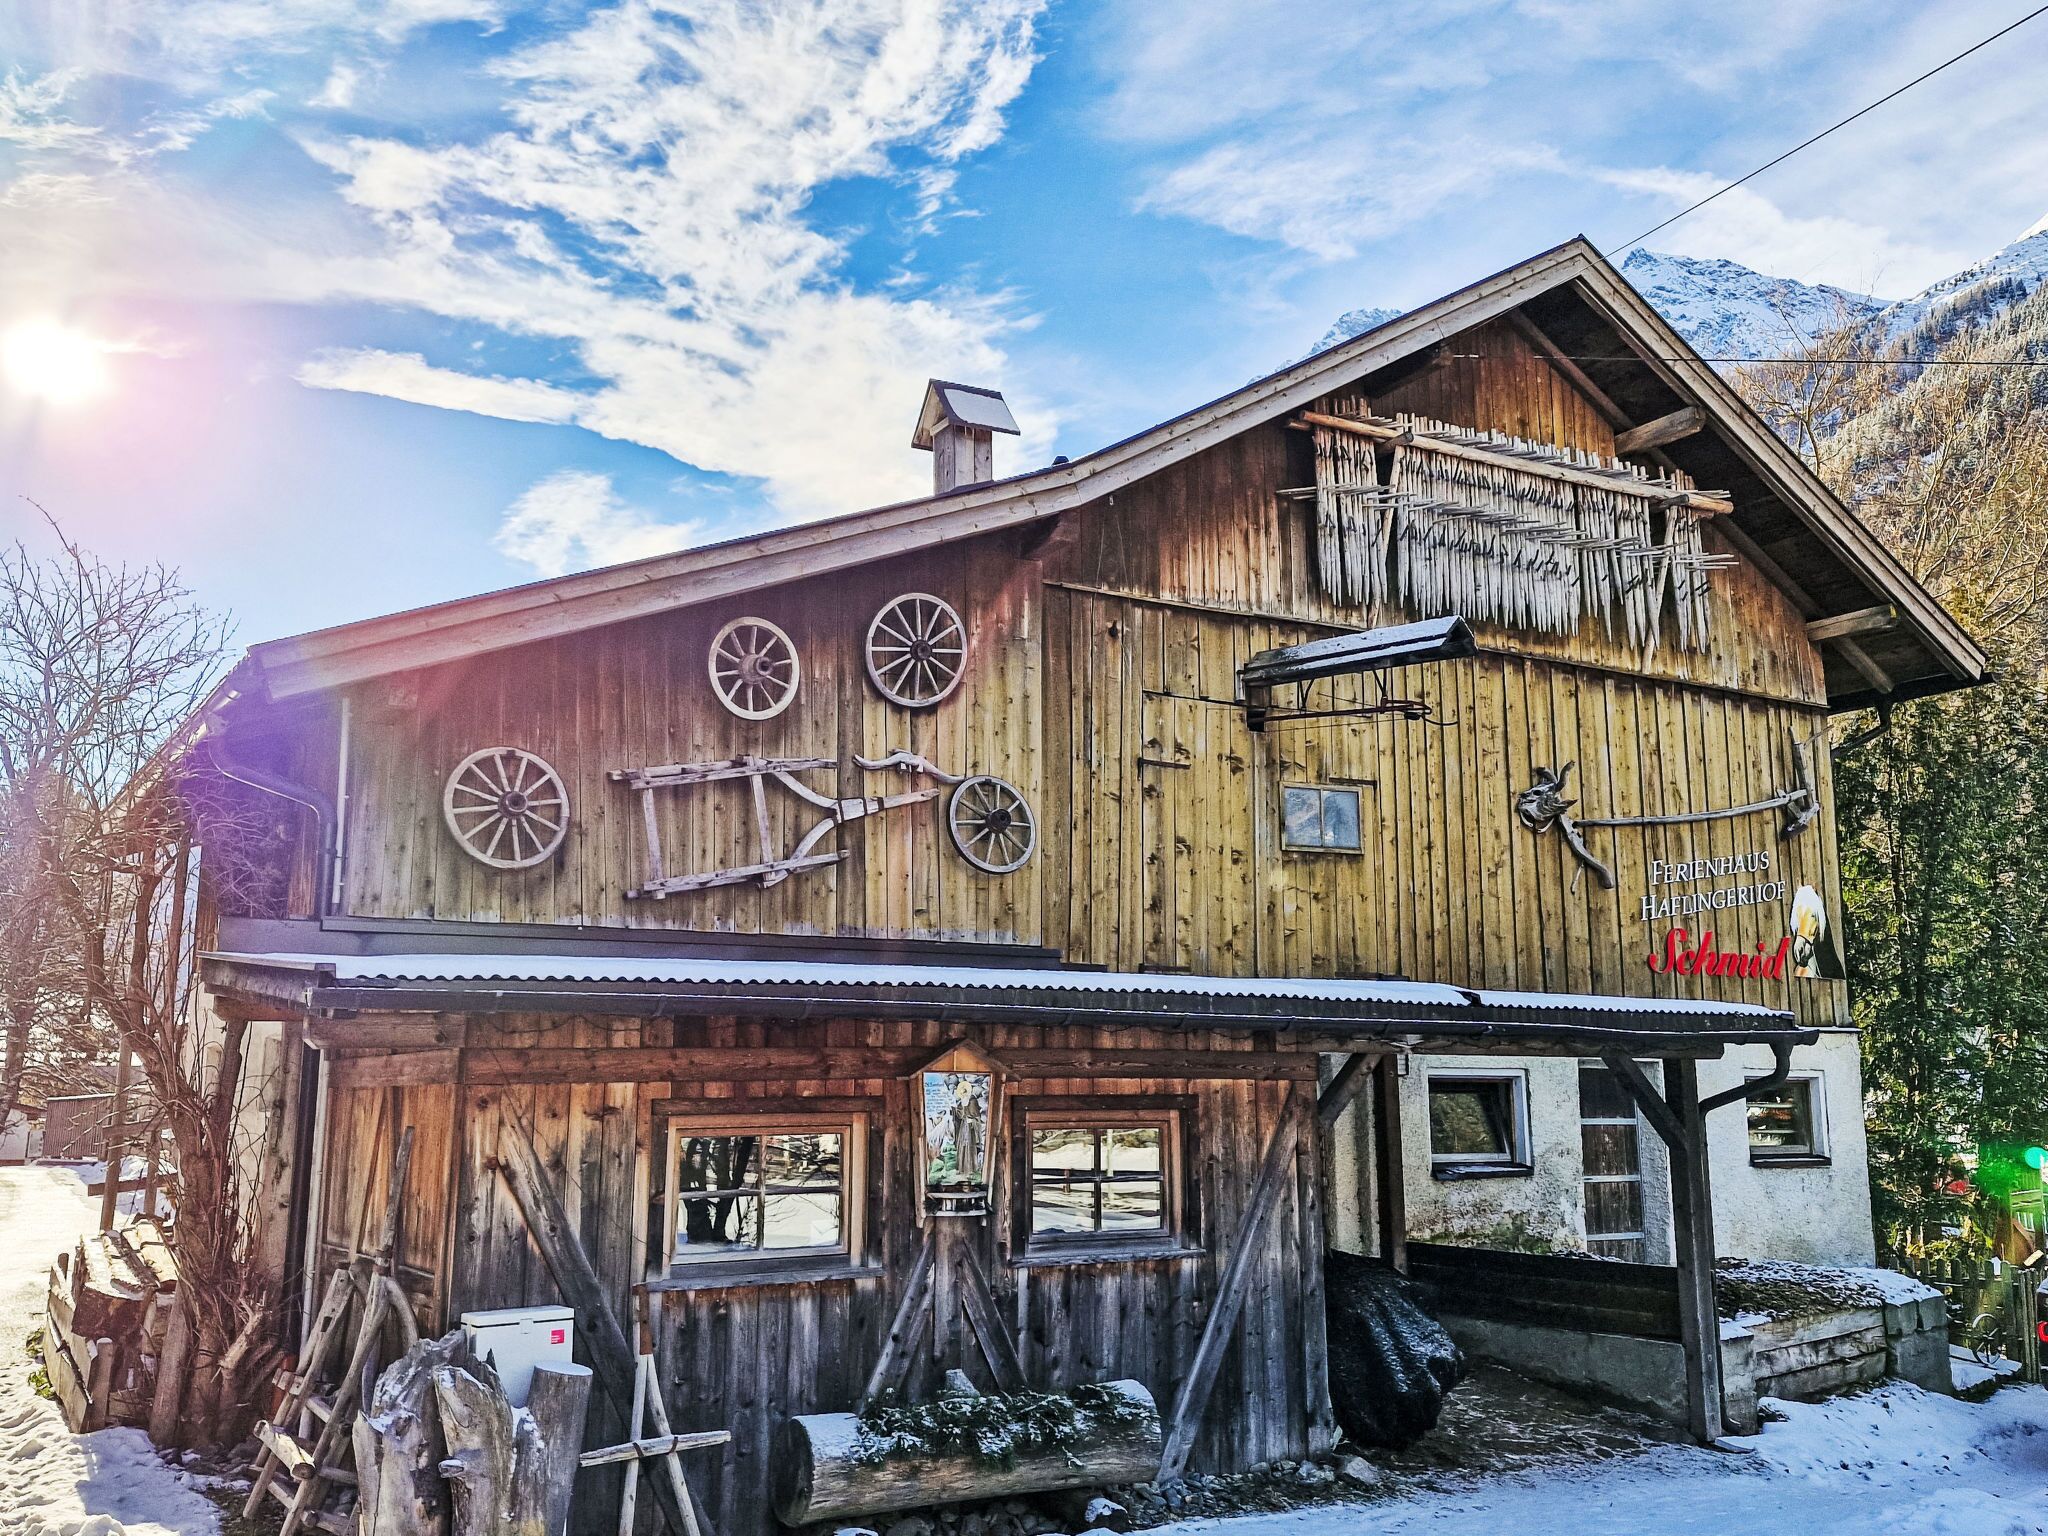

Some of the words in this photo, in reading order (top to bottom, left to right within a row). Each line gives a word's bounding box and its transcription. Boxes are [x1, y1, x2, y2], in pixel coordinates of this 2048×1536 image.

[1651, 850, 1770, 886] FERIENHAUS
[1640, 880, 1786, 922] HAFLINGERHOF
[1648, 927, 1791, 980] Schmid
